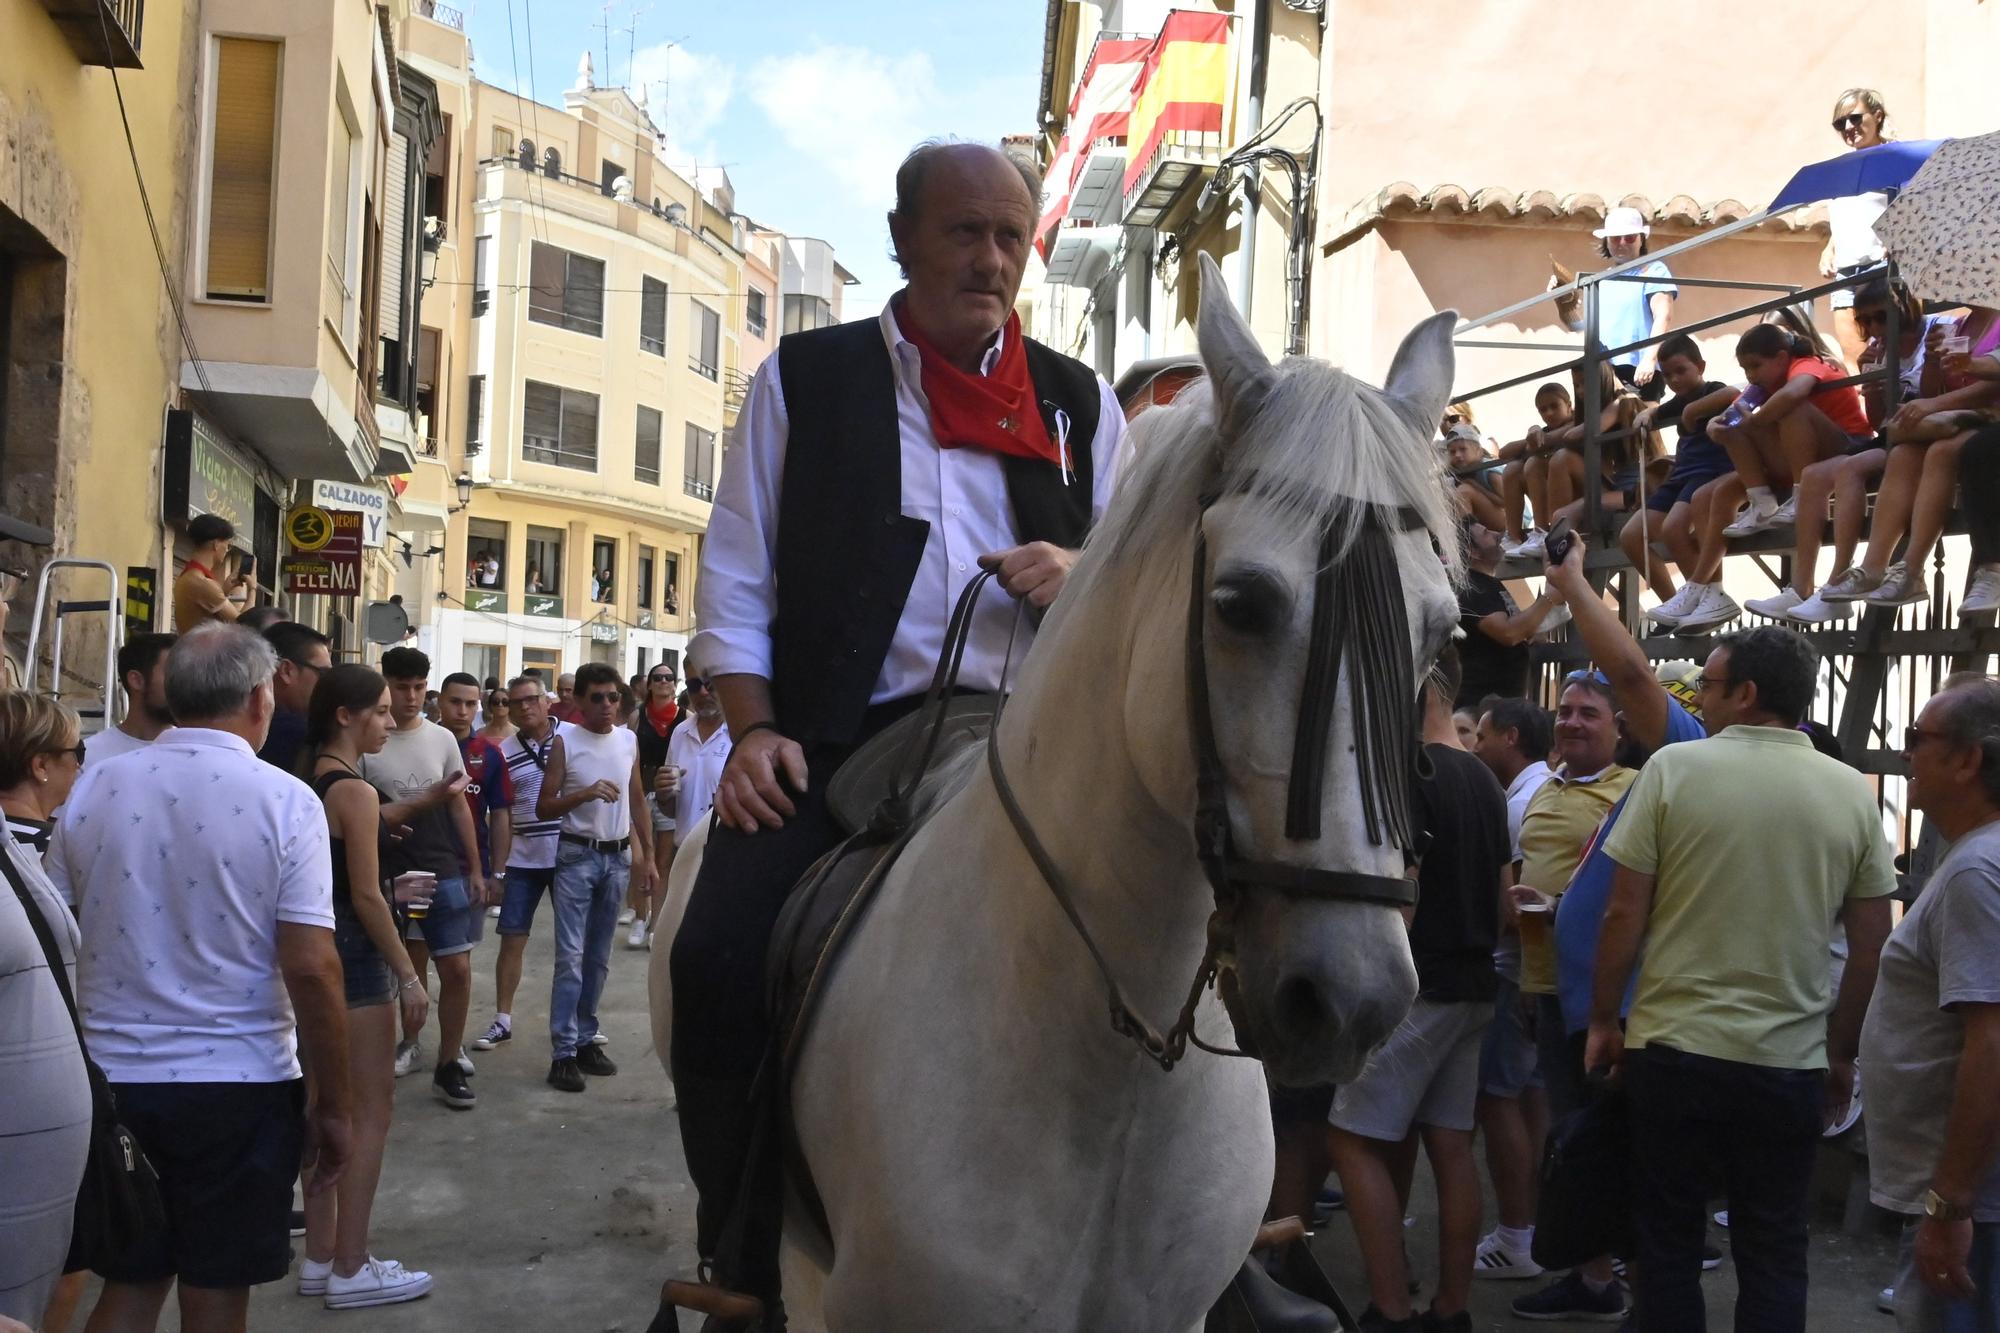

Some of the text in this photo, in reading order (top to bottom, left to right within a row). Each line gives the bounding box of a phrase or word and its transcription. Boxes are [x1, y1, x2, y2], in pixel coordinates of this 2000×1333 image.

[193, 435, 253, 508] Video Club
[319, 483, 383, 509] CALZADOS
[332, 514, 359, 528] UERIA
[285, 564, 329, 573] INTERFLORA
[296, 561, 356, 589] ELENA
